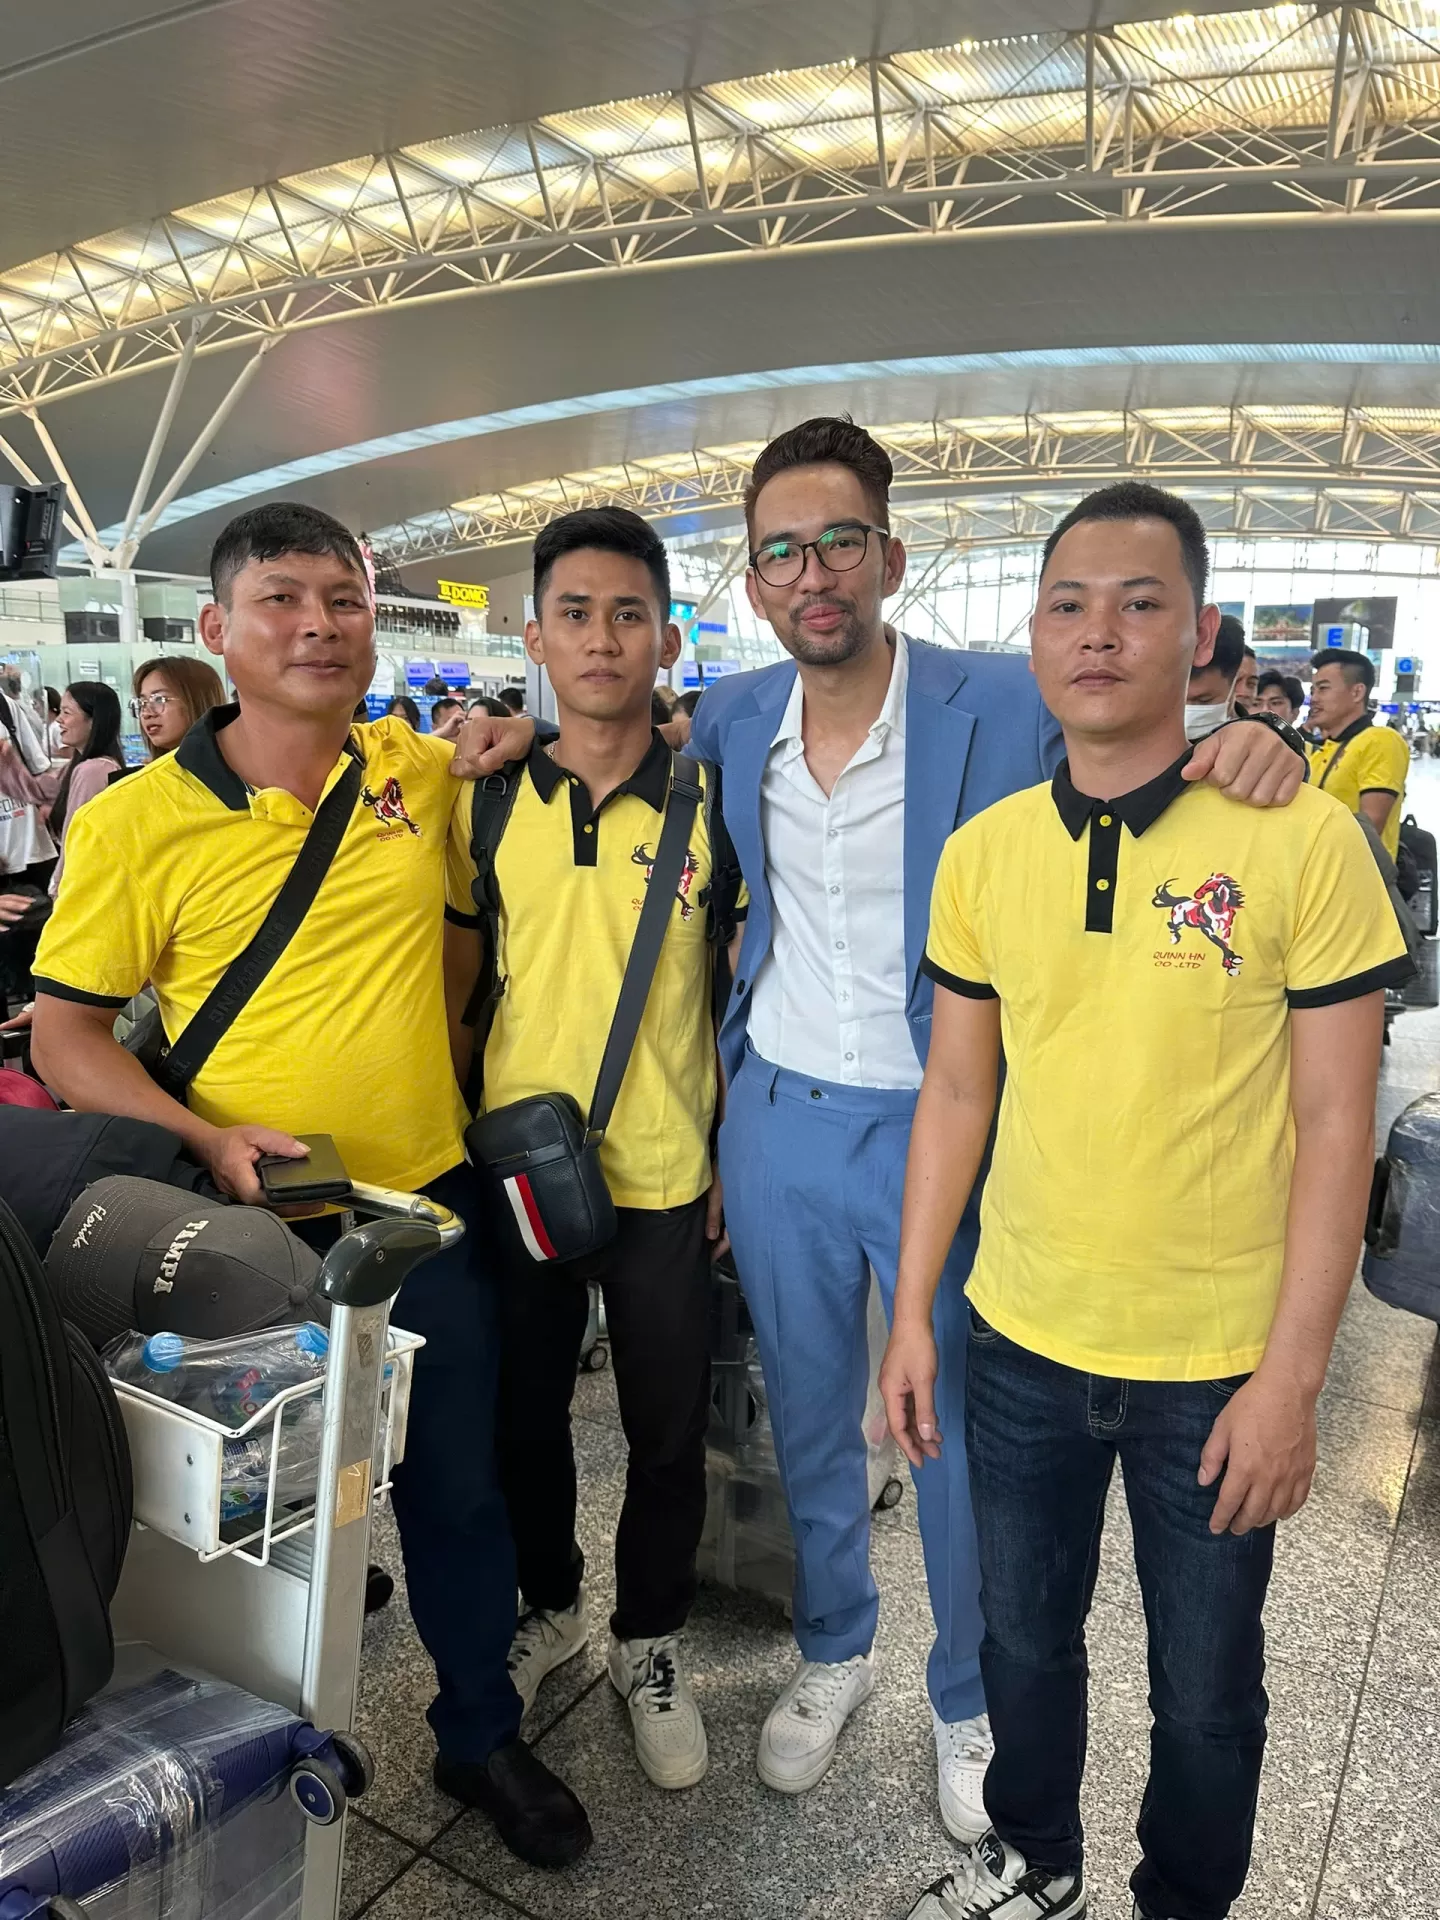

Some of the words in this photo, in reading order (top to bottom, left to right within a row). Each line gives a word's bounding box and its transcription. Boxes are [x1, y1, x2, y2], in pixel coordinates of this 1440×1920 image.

[451, 586, 487, 602] DOMO
[1328, 628, 1343, 647] E
[1153, 951, 1186, 960] QUINN
[1189, 952, 1205, 960] HN
[72, 1203, 107, 1249] Florida
[153, 1220, 209, 1294] TAMPA
